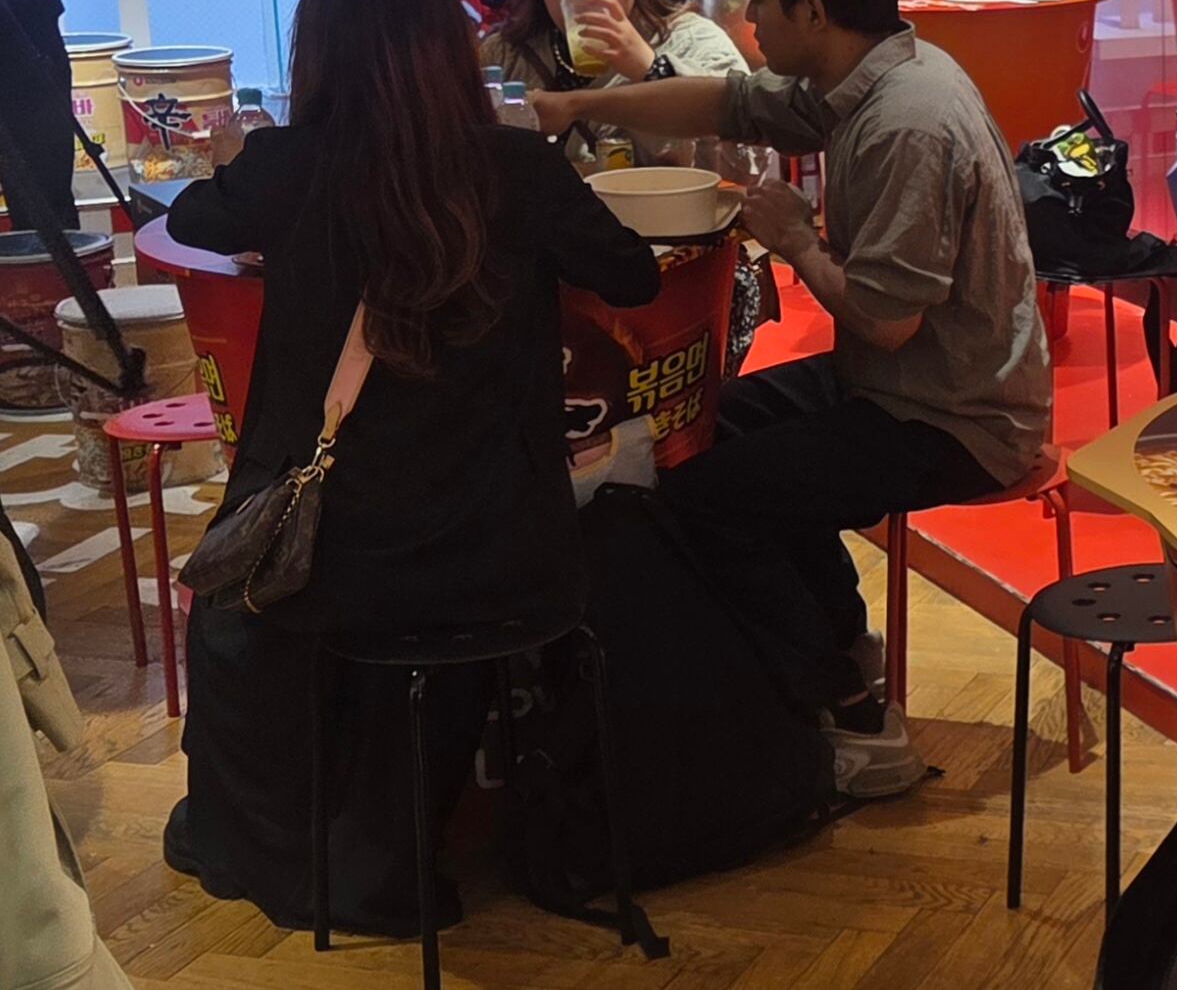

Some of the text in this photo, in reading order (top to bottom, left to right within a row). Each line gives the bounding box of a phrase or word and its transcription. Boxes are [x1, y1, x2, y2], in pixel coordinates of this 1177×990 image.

[626, 331, 710, 414] 볶음면
[653, 387, 704, 442] きそば
